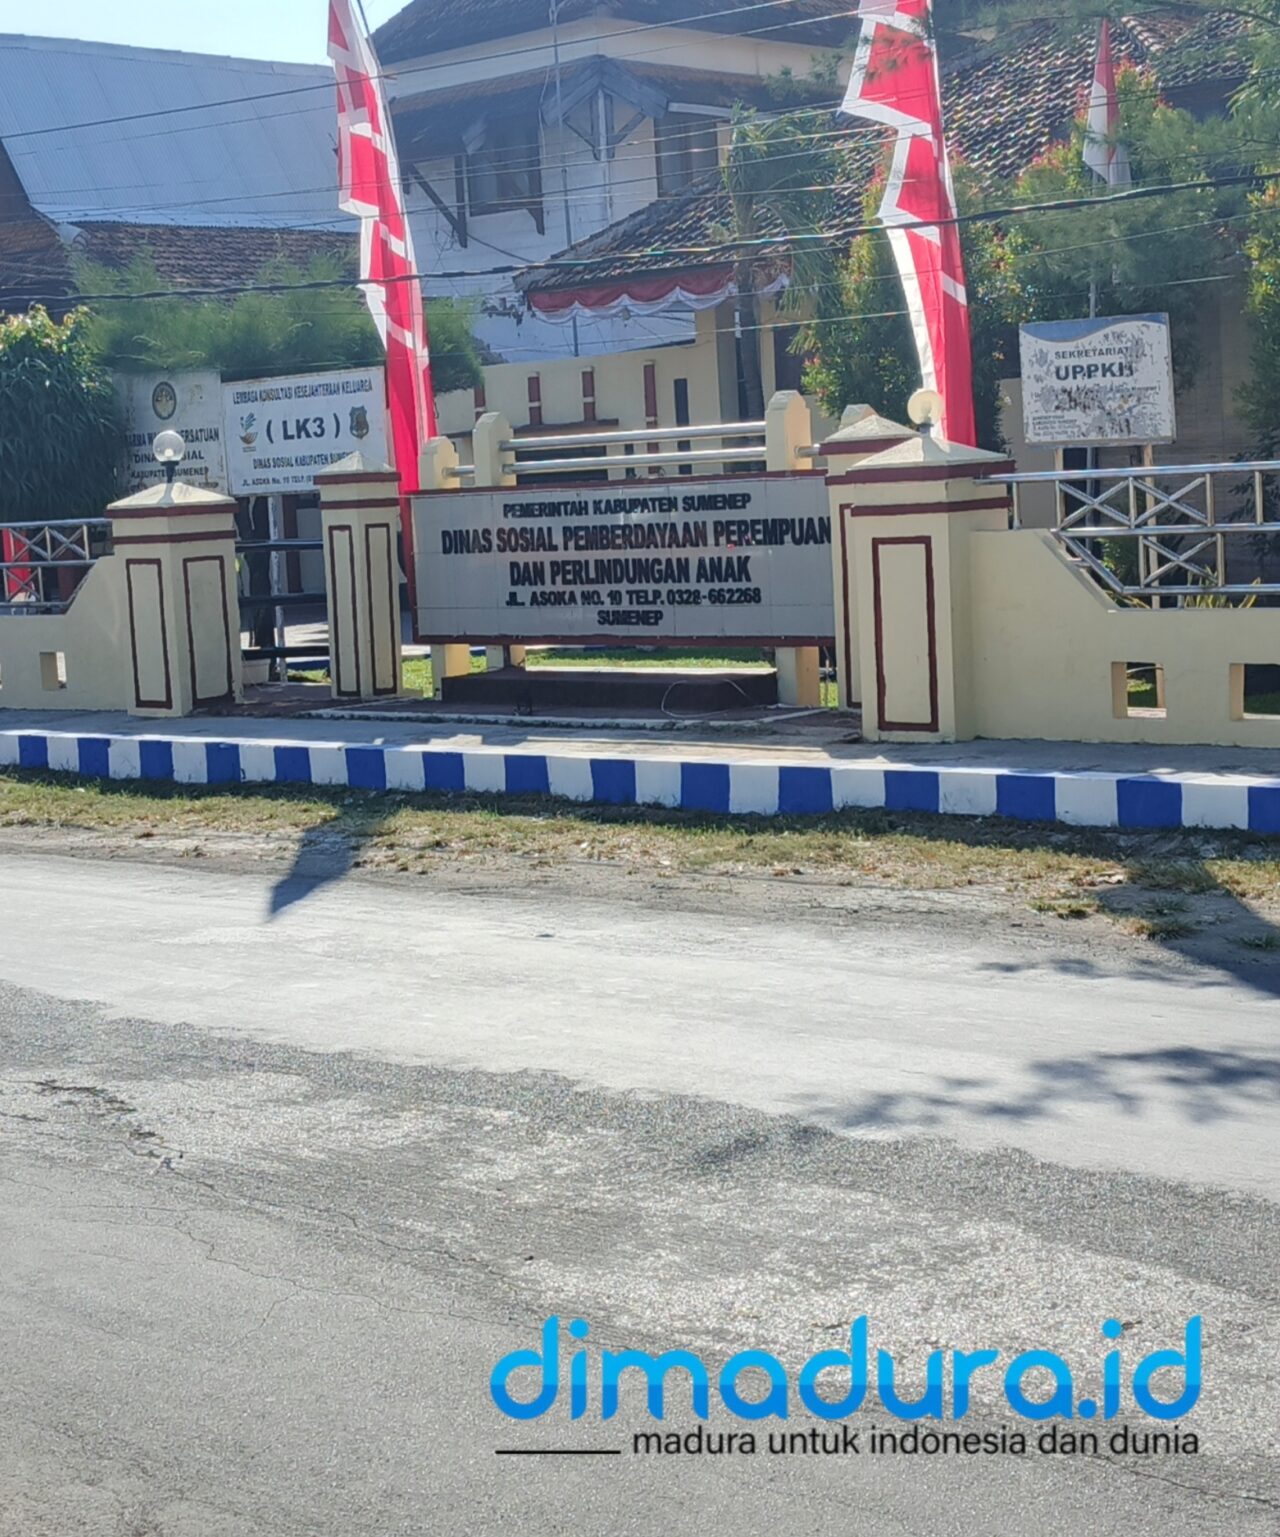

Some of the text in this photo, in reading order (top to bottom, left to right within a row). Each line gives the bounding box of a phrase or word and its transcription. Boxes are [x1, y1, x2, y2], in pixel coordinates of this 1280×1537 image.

[1055, 361, 1134, 381] UPPKH
[233, 390, 259, 405] LEMBAGA
[259, 386, 293, 402] KONSULTASI
[134, 453, 156, 464] DINA
[253, 457, 272, 469] DINAS
[272, 456, 294, 469] SOSIAL
[295, 453, 329, 467] KABUPATEN
[131, 469, 166, 479] KABUPATE
[503, 493, 752, 519] PEMERINTAH KABUPATEN SUMENEP
[441, 516, 832, 554] DINAS SOSIAL PEMBERDAYAAN PEREMPUAN
[509, 555, 752, 586] DAN PERLINDUNGAN ANAK
[506, 586, 762, 607] JL. ASOKA NO. 10 TELP. 0328-662268
[597, 609, 664, 626] SUMENEP
